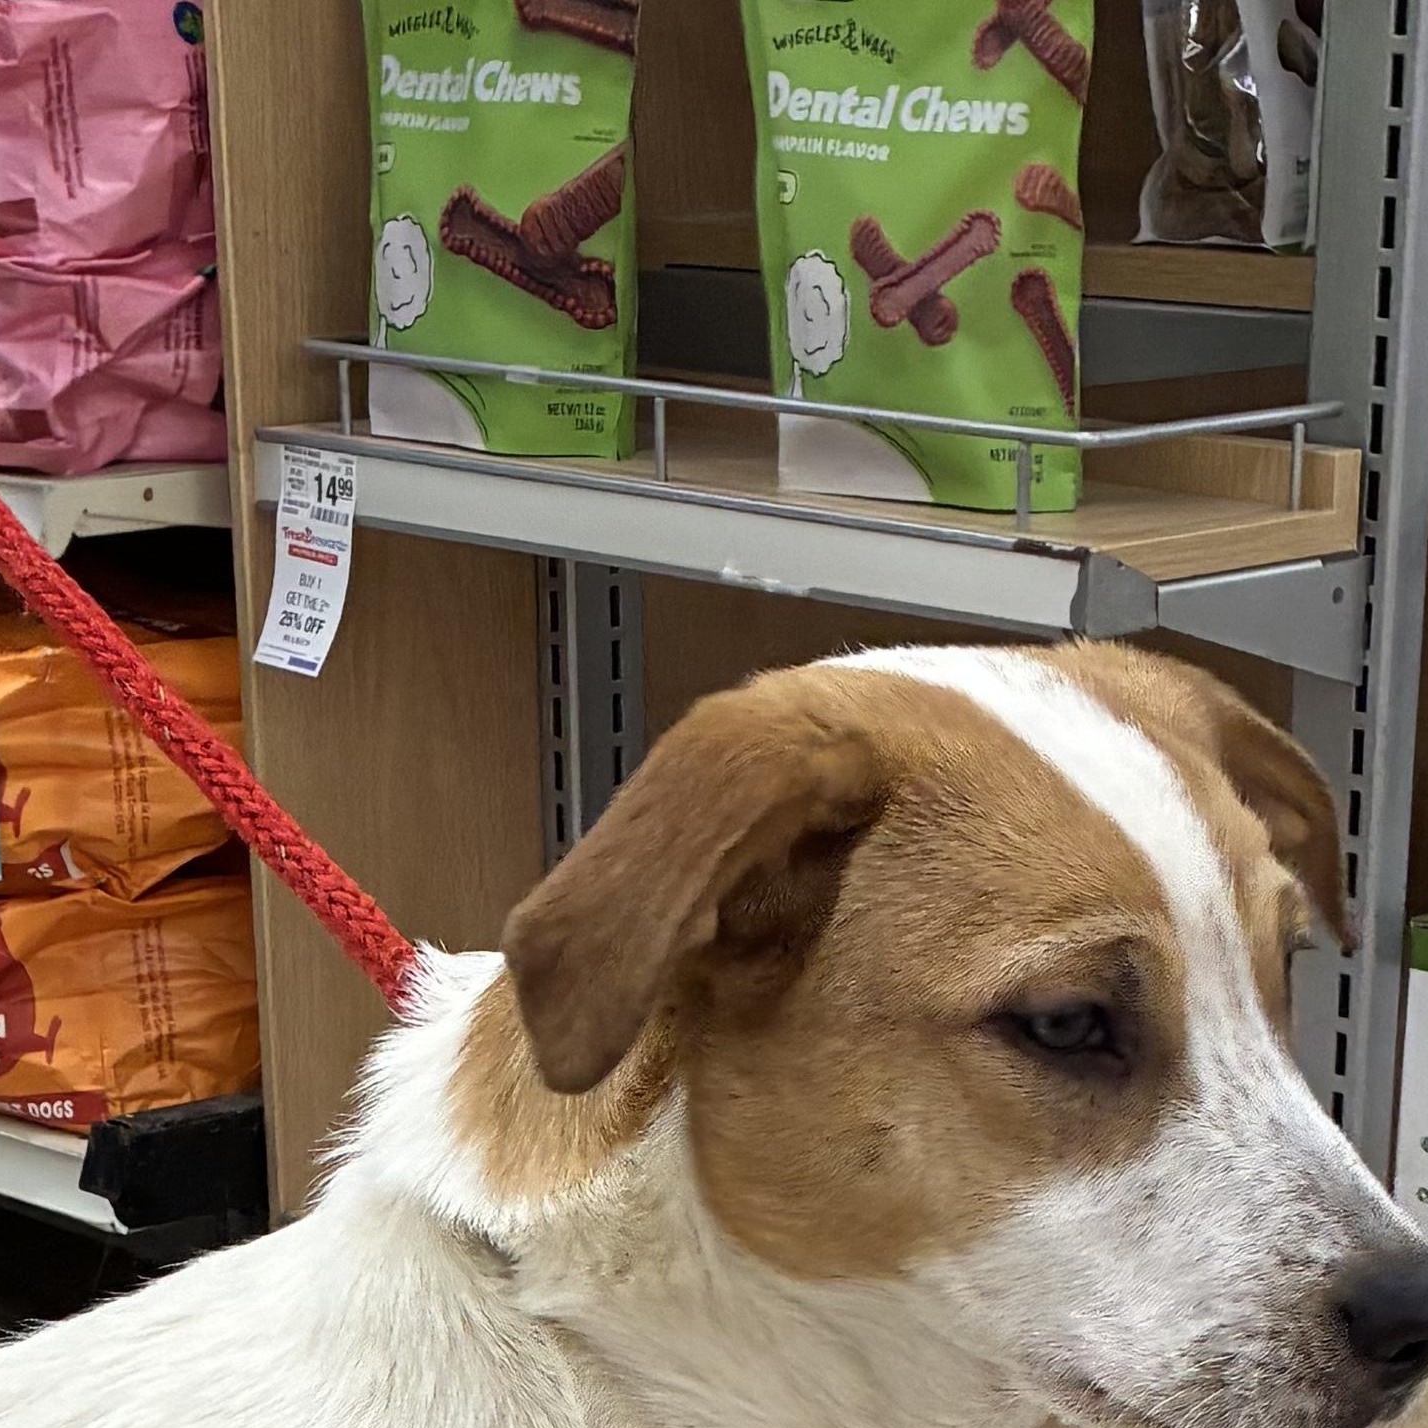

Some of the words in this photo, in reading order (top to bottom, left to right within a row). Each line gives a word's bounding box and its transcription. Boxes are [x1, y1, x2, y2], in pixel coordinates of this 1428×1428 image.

[381, 55, 474, 101] Dental
[474, 60, 581, 105] Chews
[768, 71, 899, 130] Dental
[899, 87, 1029, 135] Chews
[827, 138, 890, 162] FLAVOR
[279, 610, 302, 631] 25%
[304, 614, 326, 634] OFF
[27, 1099, 74, 1119] DOGS
